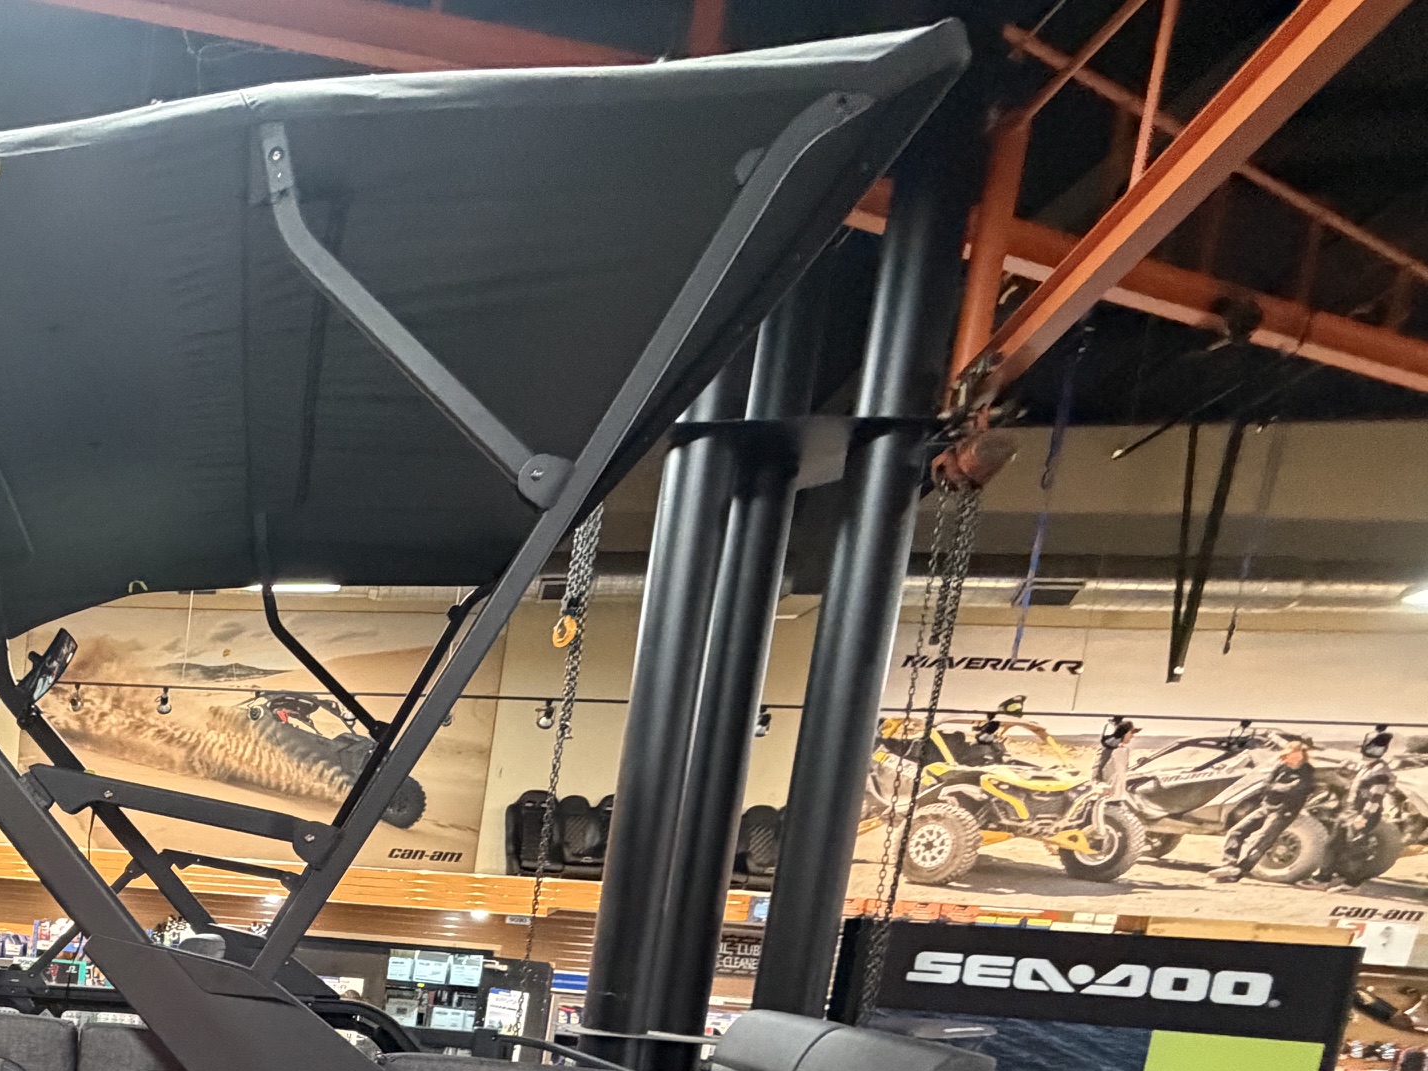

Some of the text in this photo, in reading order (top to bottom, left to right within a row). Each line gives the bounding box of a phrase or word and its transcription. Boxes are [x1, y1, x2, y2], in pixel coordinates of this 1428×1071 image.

[901, 654, 1084, 675] MAVERICK R
[388, 847, 463, 863] can-am
[1329, 905, 1425, 921] can-am
